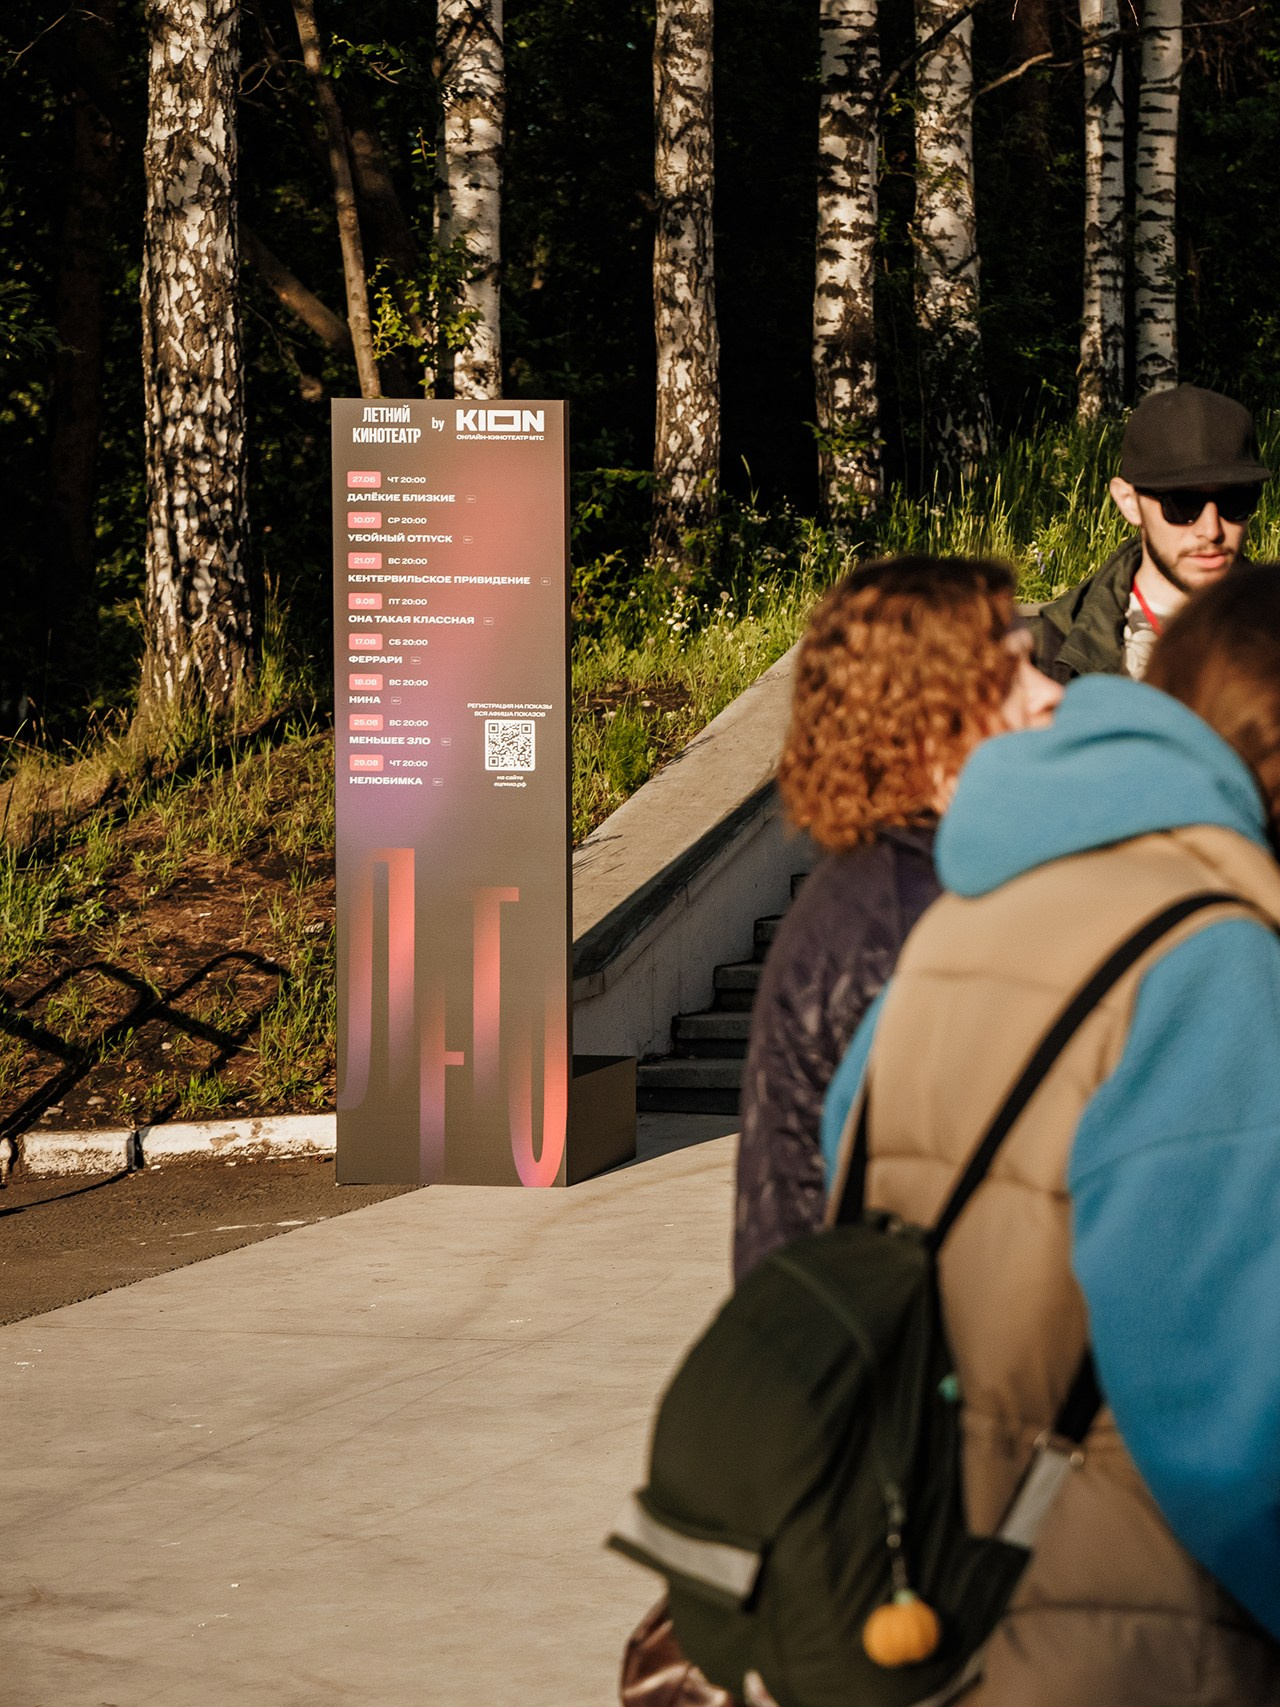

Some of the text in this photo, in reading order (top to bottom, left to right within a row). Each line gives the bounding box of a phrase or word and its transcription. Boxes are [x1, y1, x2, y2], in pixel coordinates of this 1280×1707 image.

[362, 405, 411, 423] ЛЕТНИЙ
[431, 418, 445, 431] by
[456, 409, 545, 432] KION
[353, 428, 422, 444] КИНОТЕАТР
[400, 476, 426, 484] 20:00
[347, 493, 400, 503] ДАЛЁКИЕ
[402, 494, 456, 502] БЛИЗКИЕ
[348, 533, 405, 543] УБОЙНЫЙ
[407, 535, 453, 543] ОТПУСК
[348, 575, 452, 583] КЕНТЕРВИЛЬСКОЕ
[454, 576, 531, 585] ПРИВИДЕНИЕ
[375, 616, 411, 624] ТАКАЯ
[413, 616, 475, 625] КЛАССНАЯ
[349, 656, 403, 664] ФЕРРАРИ
[349, 696, 381, 704] НИНА
[349, 737, 431, 745] МЕНЬШЕЕ ЗЛО
[350, 777, 423, 785] НЕЛЮБИМКА
